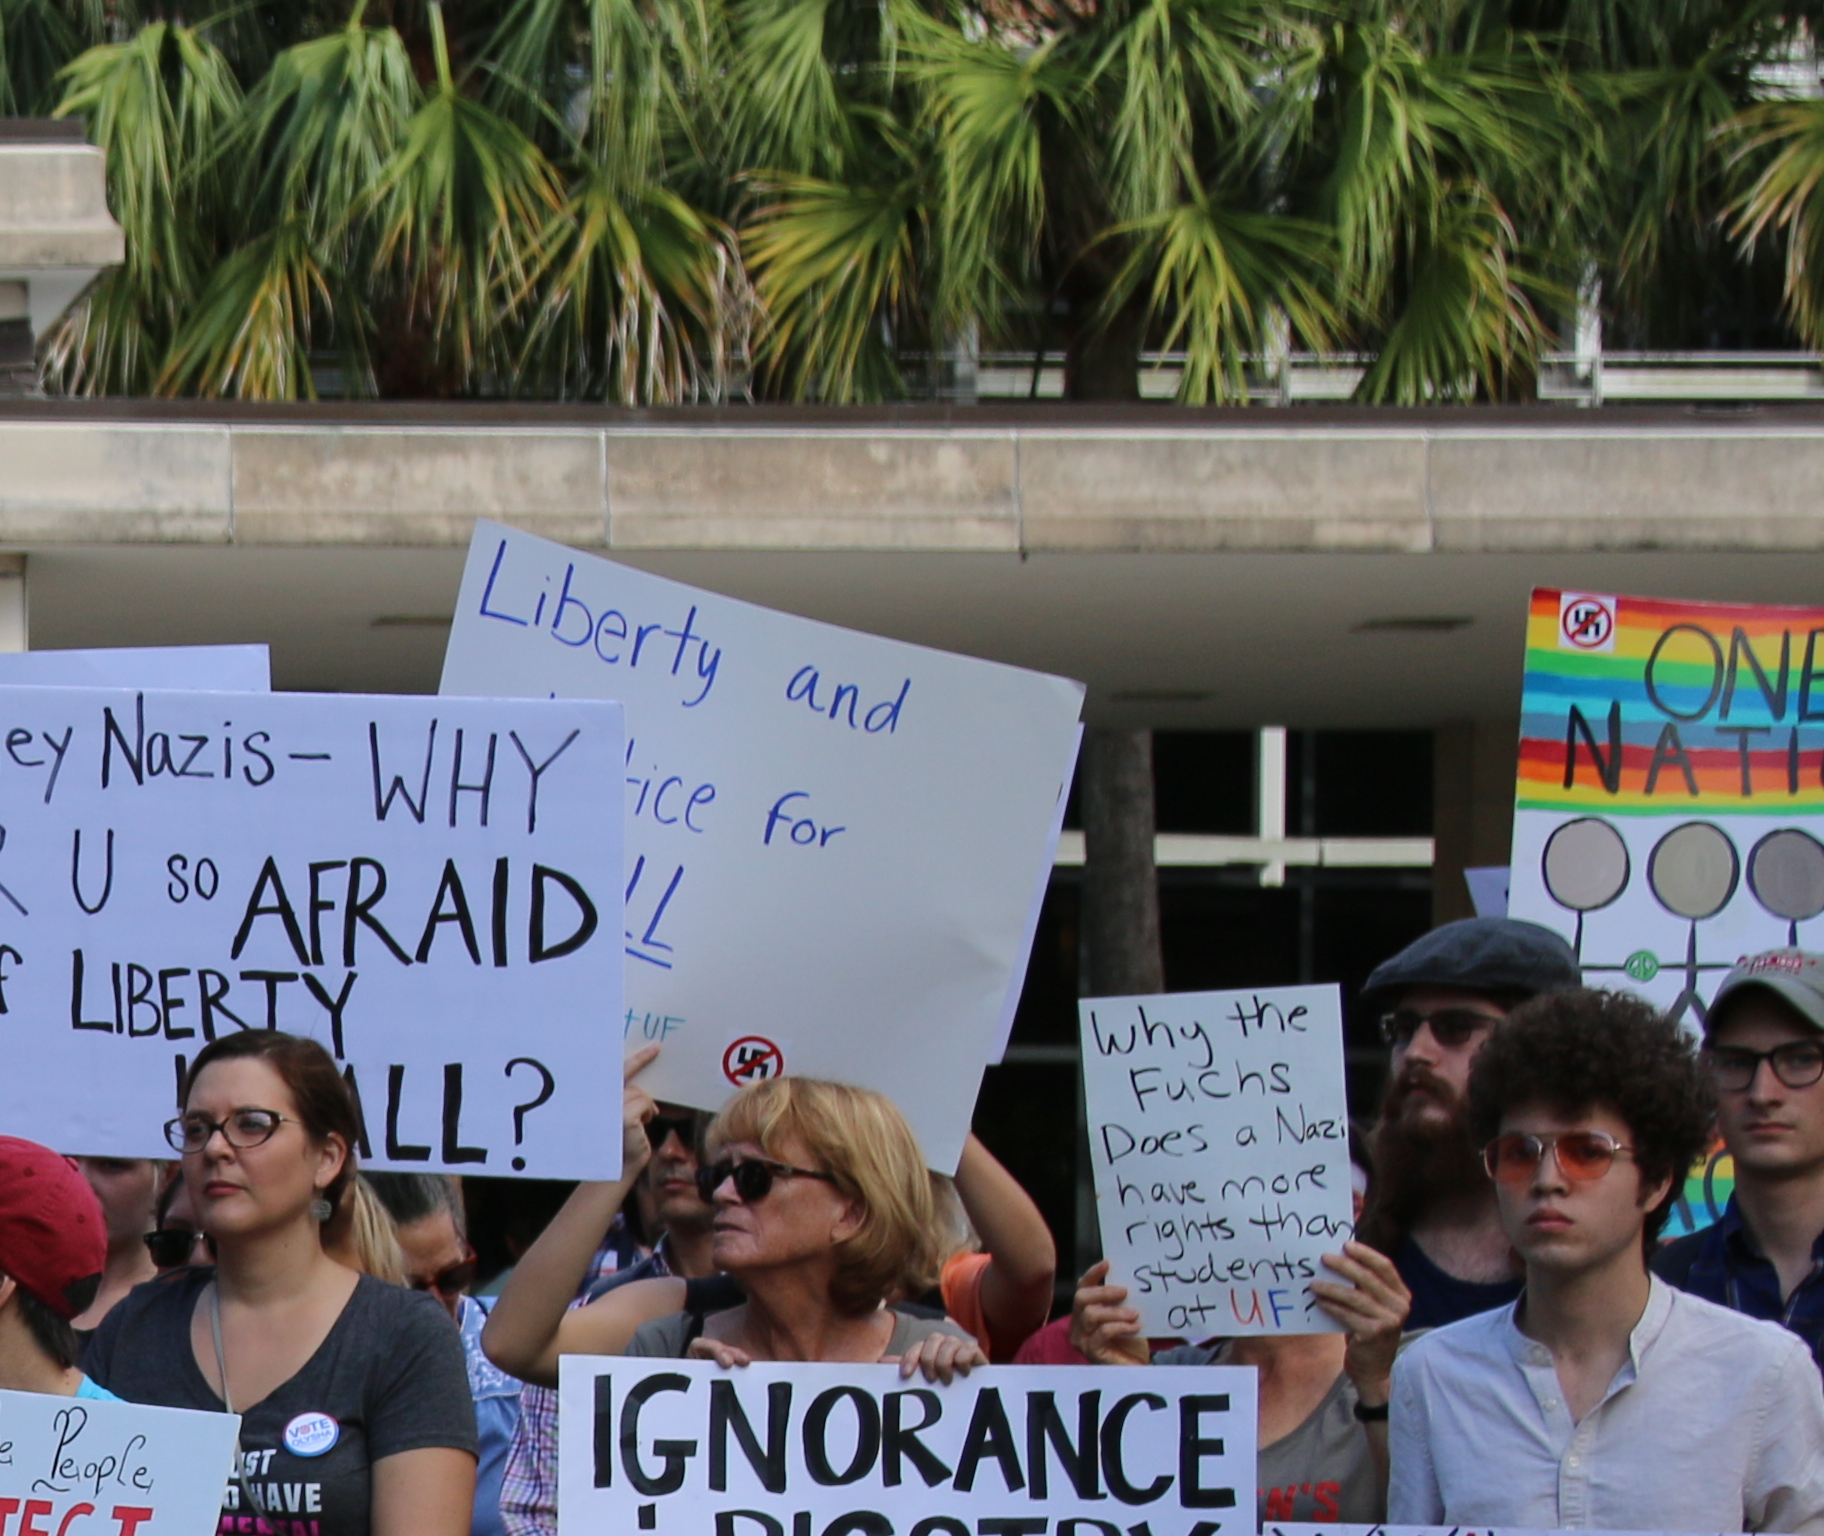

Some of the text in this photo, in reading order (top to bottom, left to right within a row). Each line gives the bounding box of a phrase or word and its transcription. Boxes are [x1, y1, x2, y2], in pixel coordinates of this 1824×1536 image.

[479, 539, 912, 735] Liberty and
[368, 718, 581, 834] WHY
[71, 827, 115, 915] U
[231, 854, 599, 967] AFRAID
[72, 948, 359, 1061] LIBERTY
[1090, 994, 1309, 1070] Why the
[1129, 1059, 1292, 1114] Fuchs
[1102, 1122, 1209, 1166] Does
[1276, 1103, 1347, 1145] Nazi
[1116, 1162, 1328, 1208] have more
[1125, 1201, 1354, 1262] rights than
[1133, 1252, 1317, 1294] students
[1167, 1294, 1217, 1330] at
[593, 1372, 1237, 1509] IGNORANCE
